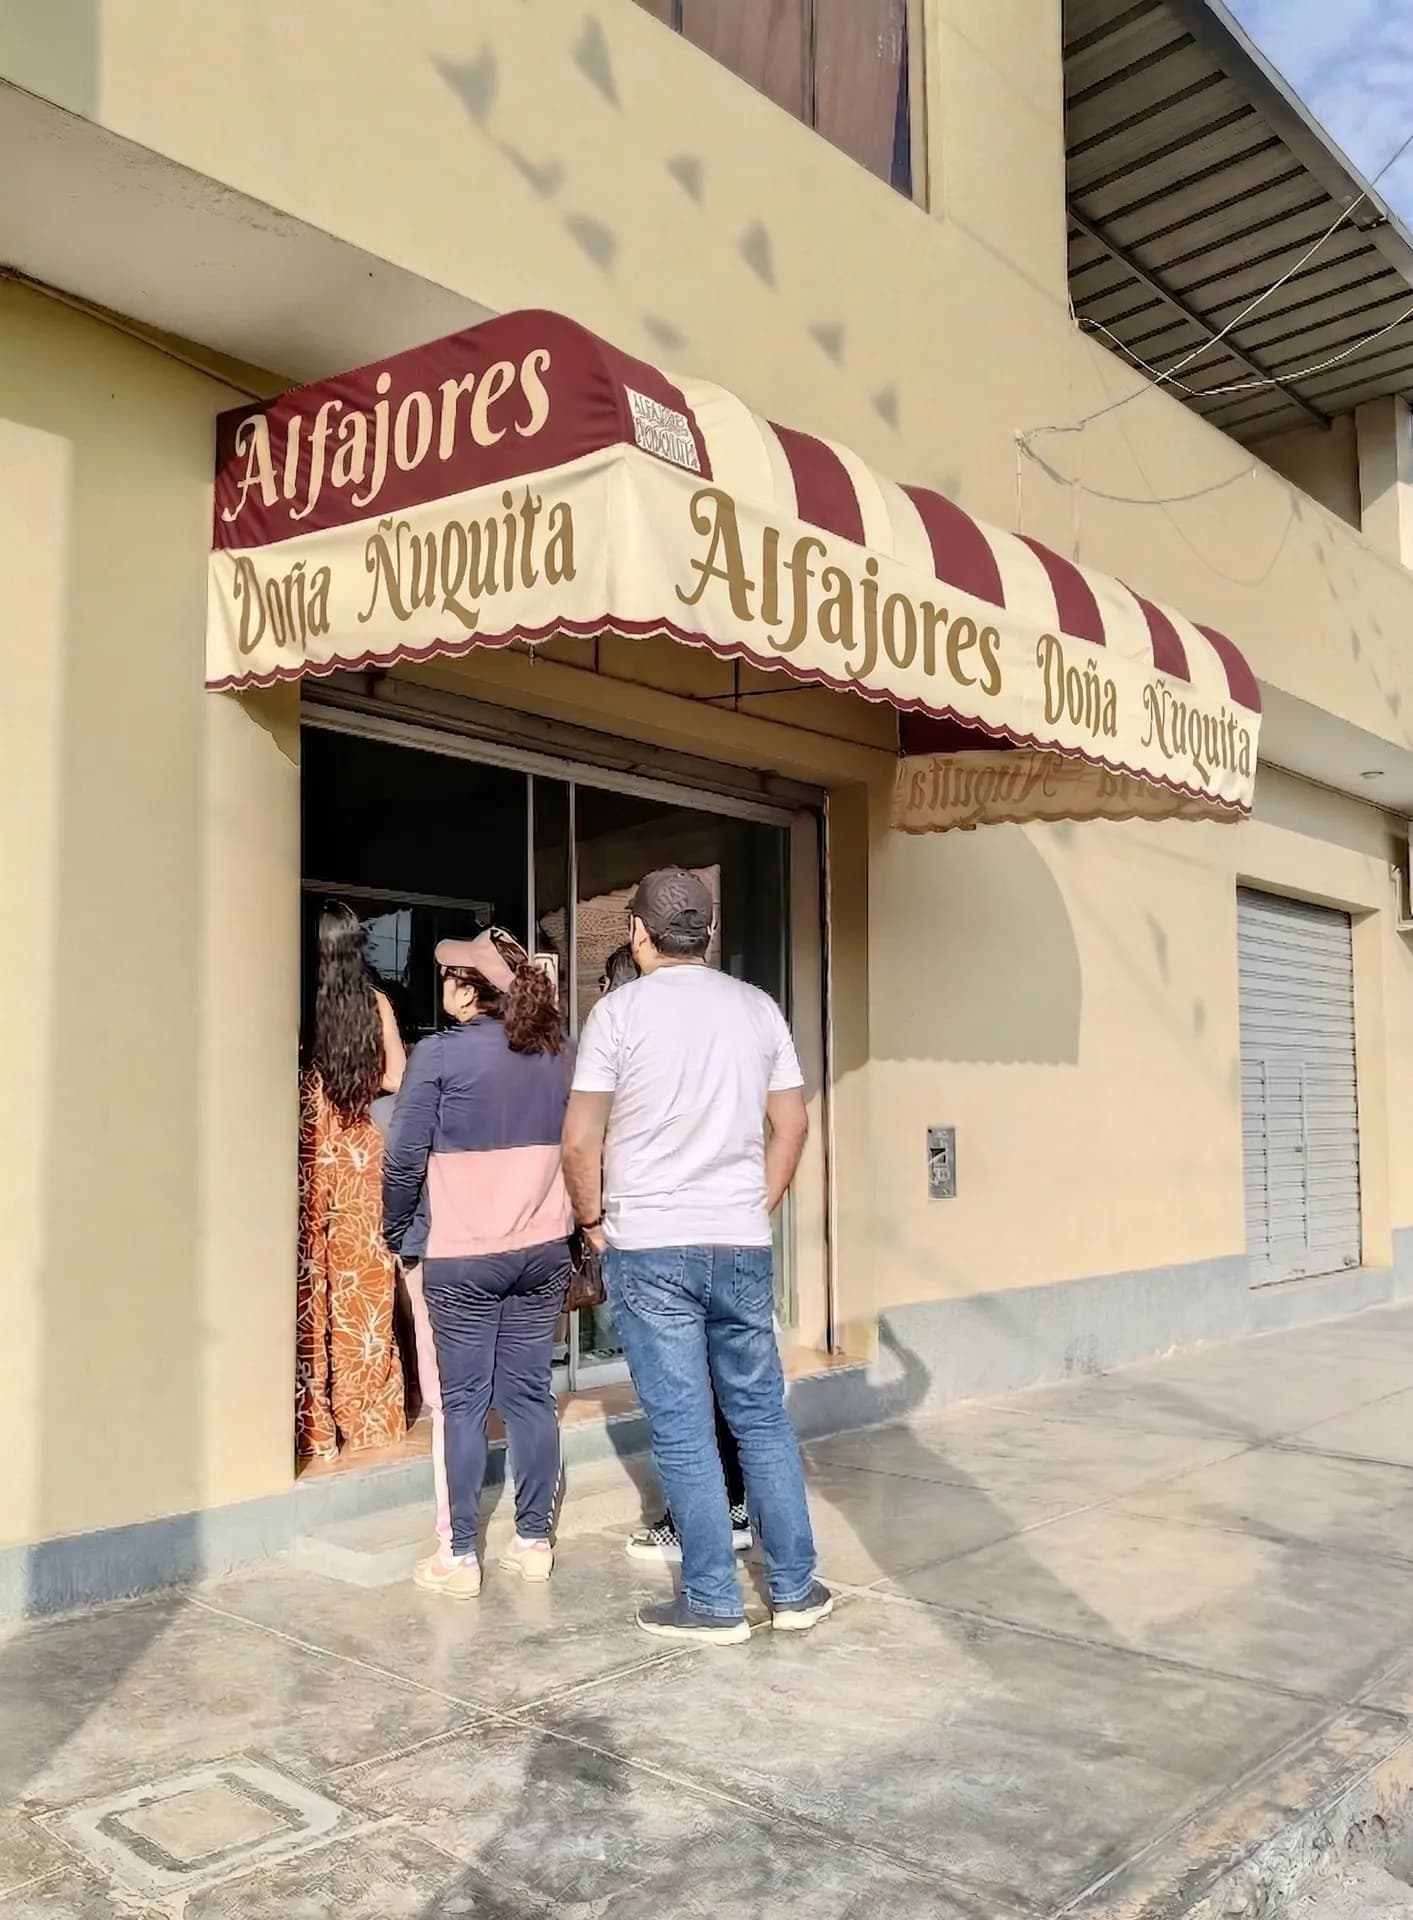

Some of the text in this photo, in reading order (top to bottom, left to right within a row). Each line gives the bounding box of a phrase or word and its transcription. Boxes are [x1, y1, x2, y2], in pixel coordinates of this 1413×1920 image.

[222, 349, 550, 522] Alfajores
[233, 556, 331, 656] Doña
[675, 488, 1001, 696] Alfajores
[1036, 633, 1118, 738] Doña
